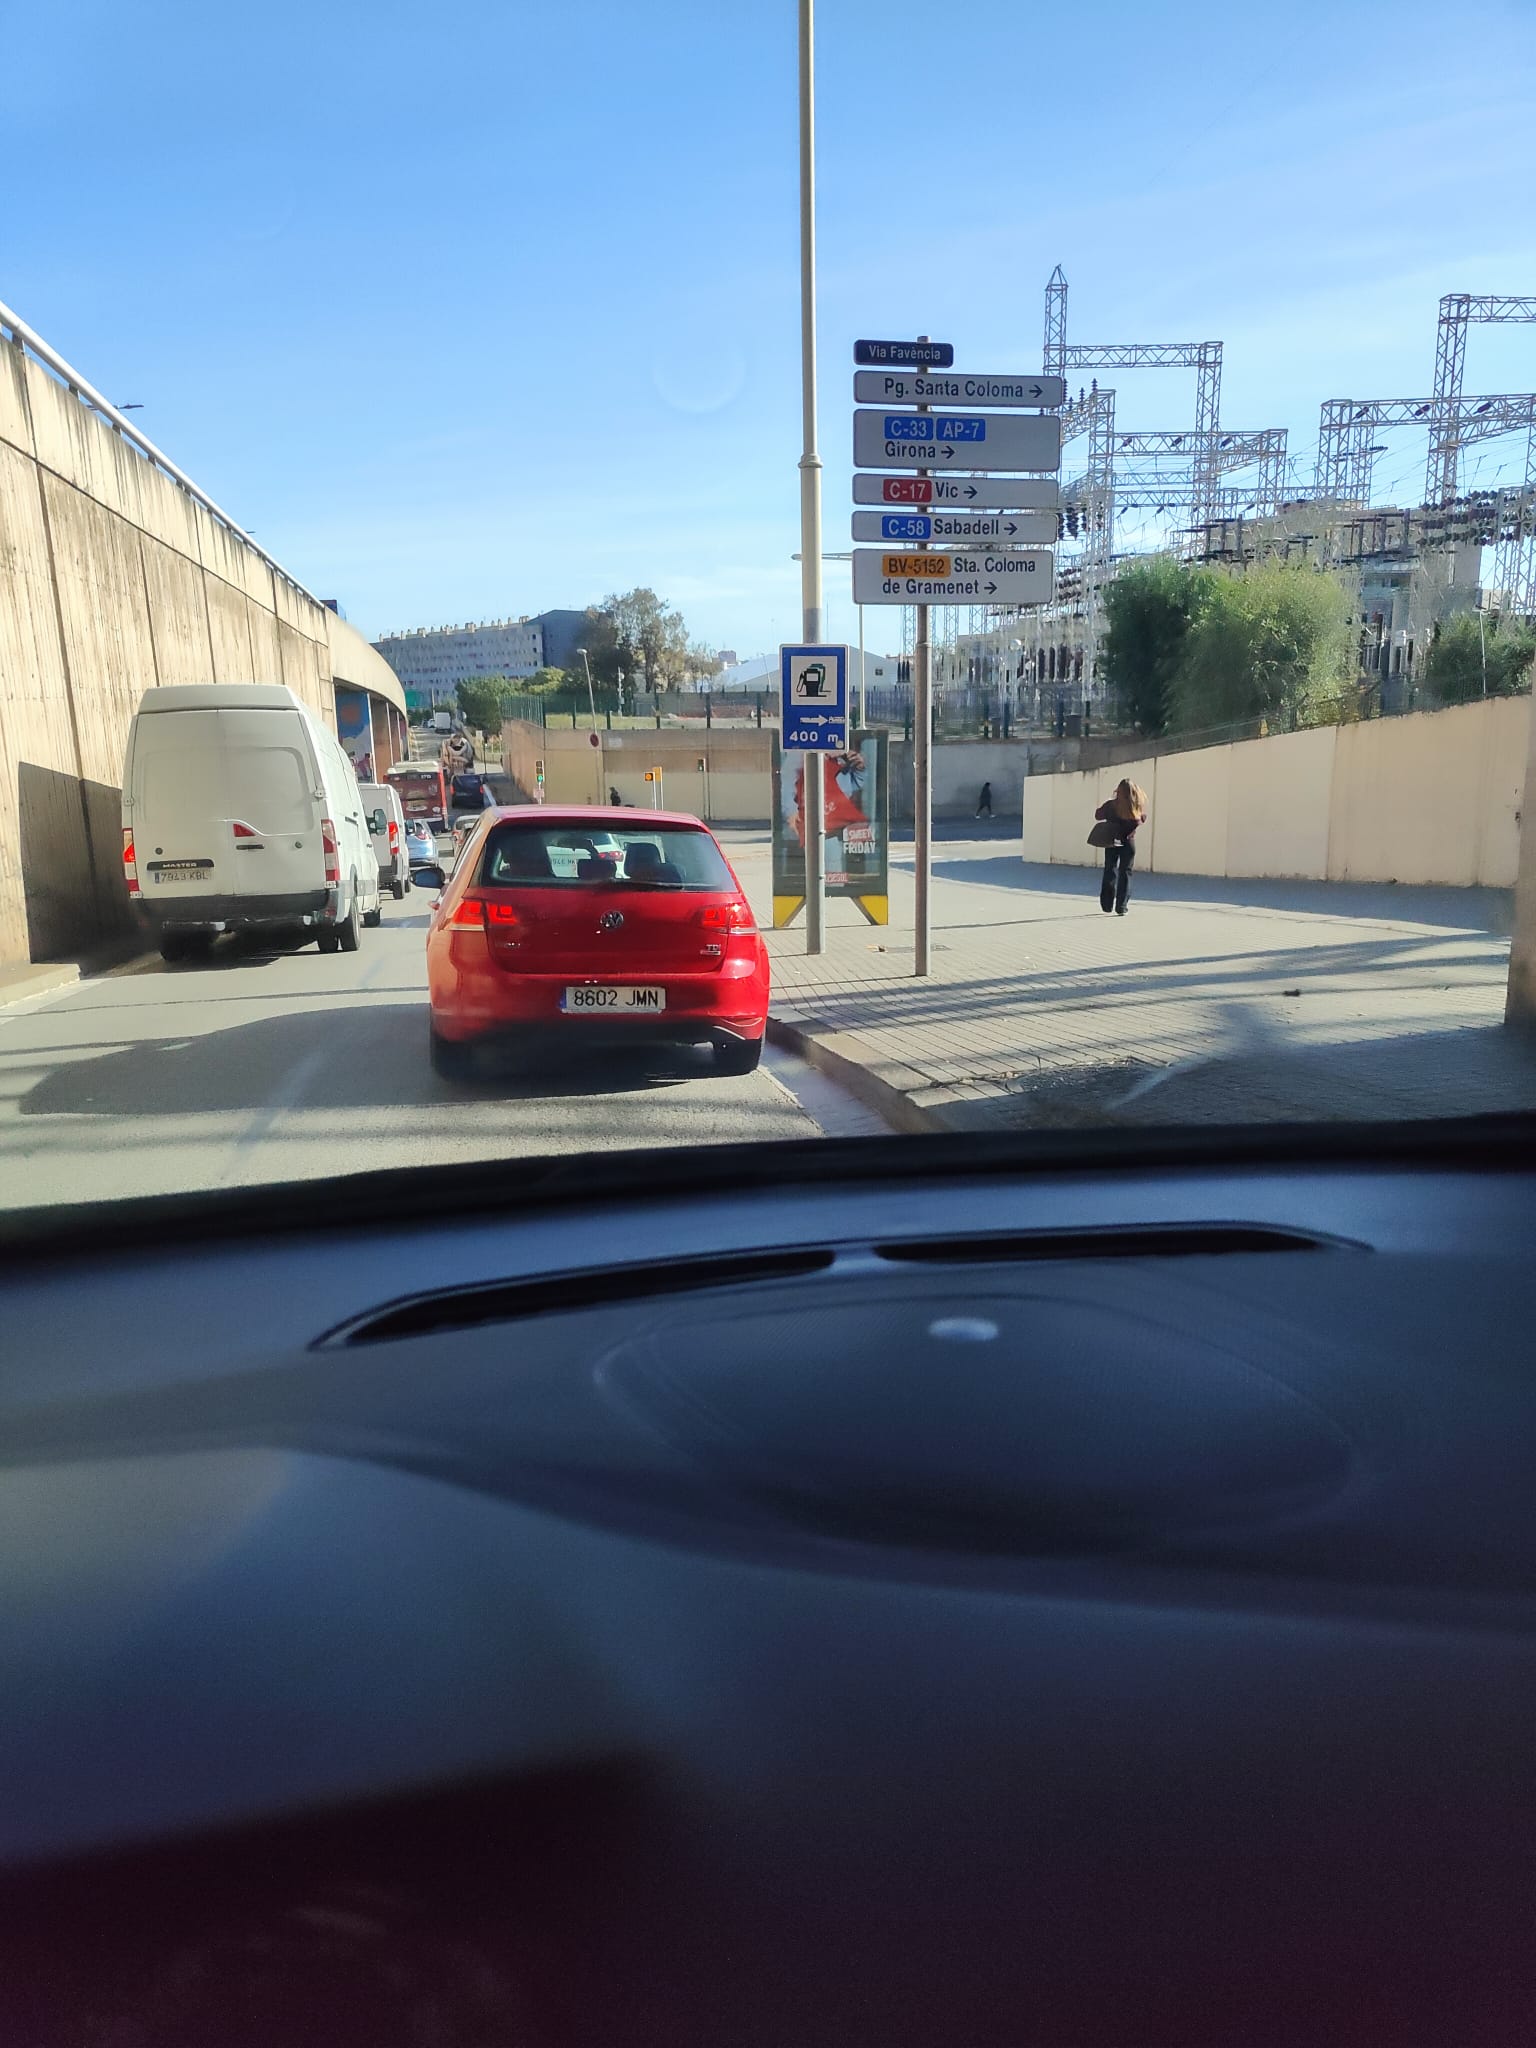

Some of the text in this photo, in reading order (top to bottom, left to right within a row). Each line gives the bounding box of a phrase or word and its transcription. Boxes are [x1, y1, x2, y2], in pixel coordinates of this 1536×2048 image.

[868, 345, 941, 361] Via Favència
[884, 378, 1023, 398] Pg. Santa Coloma
[890, 420, 980, 439] C-33 AP-7
[885, 441, 936, 458] Girona
[889, 482, 958, 499] C-17 Vic
[888, 519, 999, 536] C-58 Sabadell
[888, 557, 1036, 574] BV-5152 Sta. Coloma
[882, 579, 979, 595] de Gramenet
[789, 731, 839, 743] 400 m
[843, 841, 876, 854] FRIDAY
[573, 989, 659, 1007] 8602 JMN
